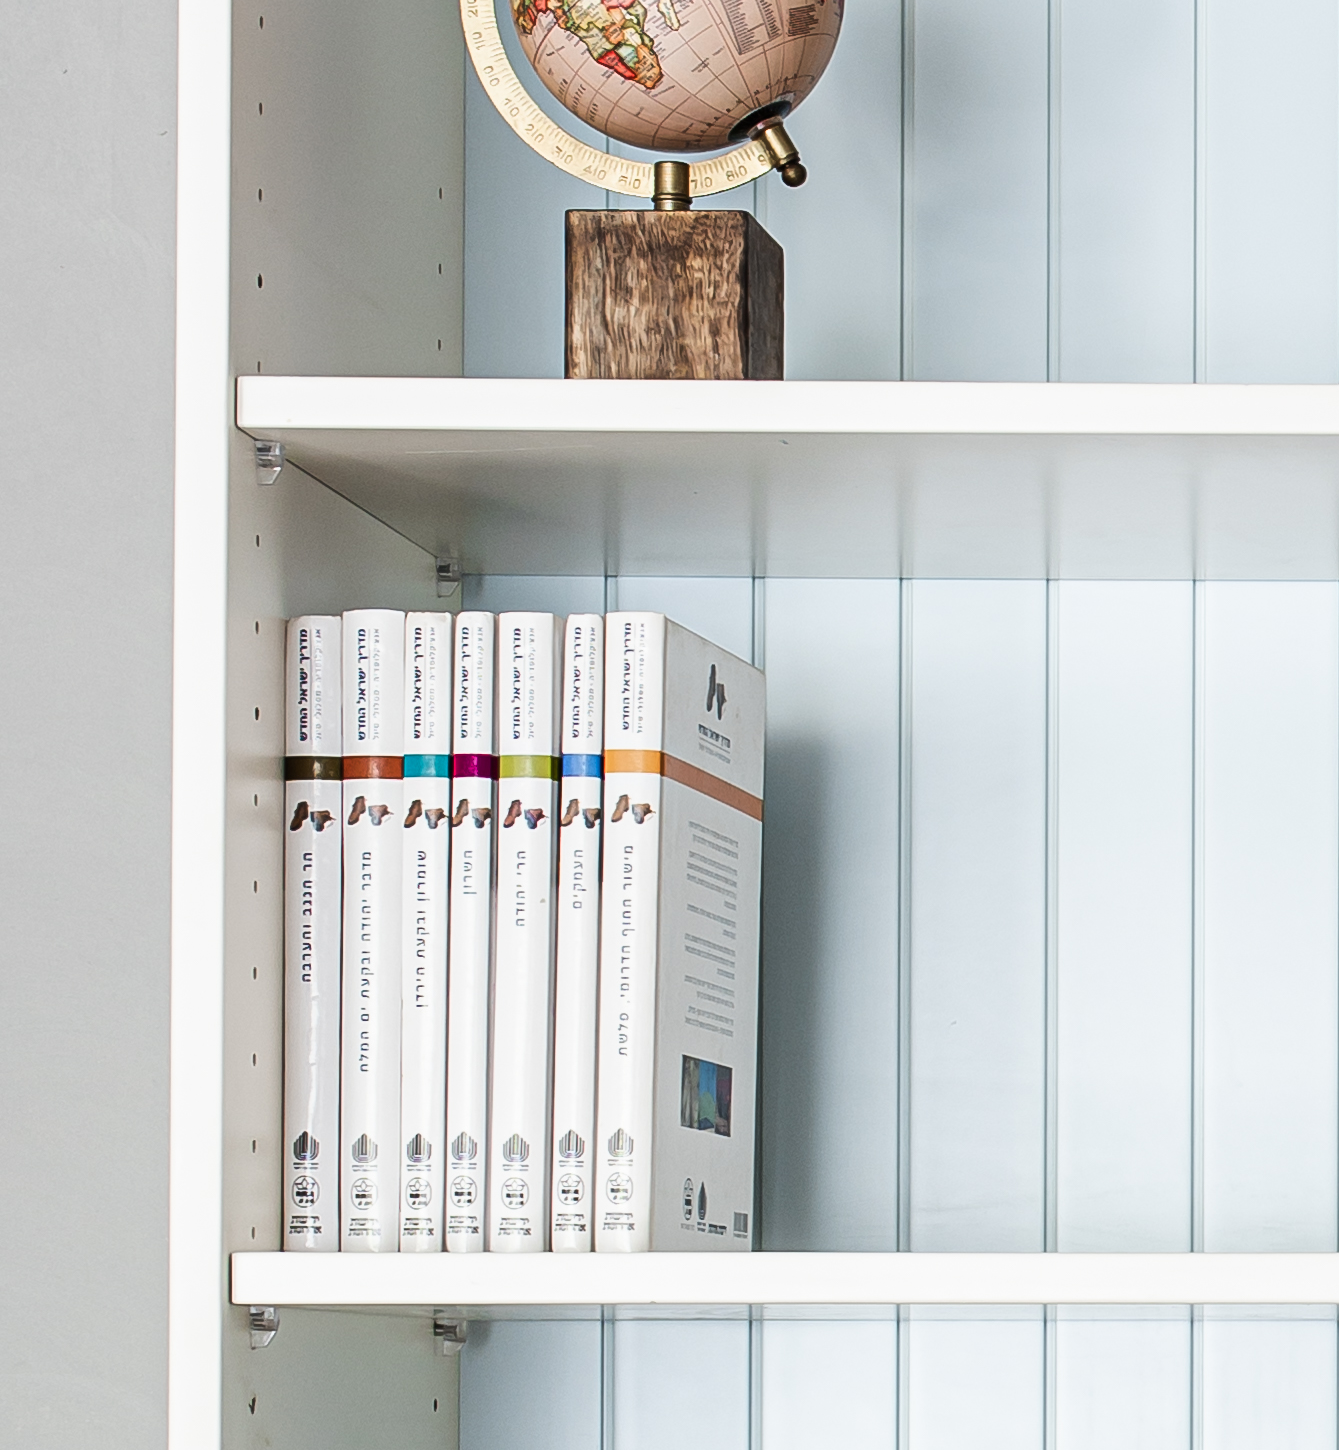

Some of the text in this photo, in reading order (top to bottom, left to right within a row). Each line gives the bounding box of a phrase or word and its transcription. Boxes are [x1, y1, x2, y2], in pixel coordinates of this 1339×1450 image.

[298, 629, 311, 741] מדריך ישראל החדש
[356, 628, 368, 741] מדריך ישראל החדש
